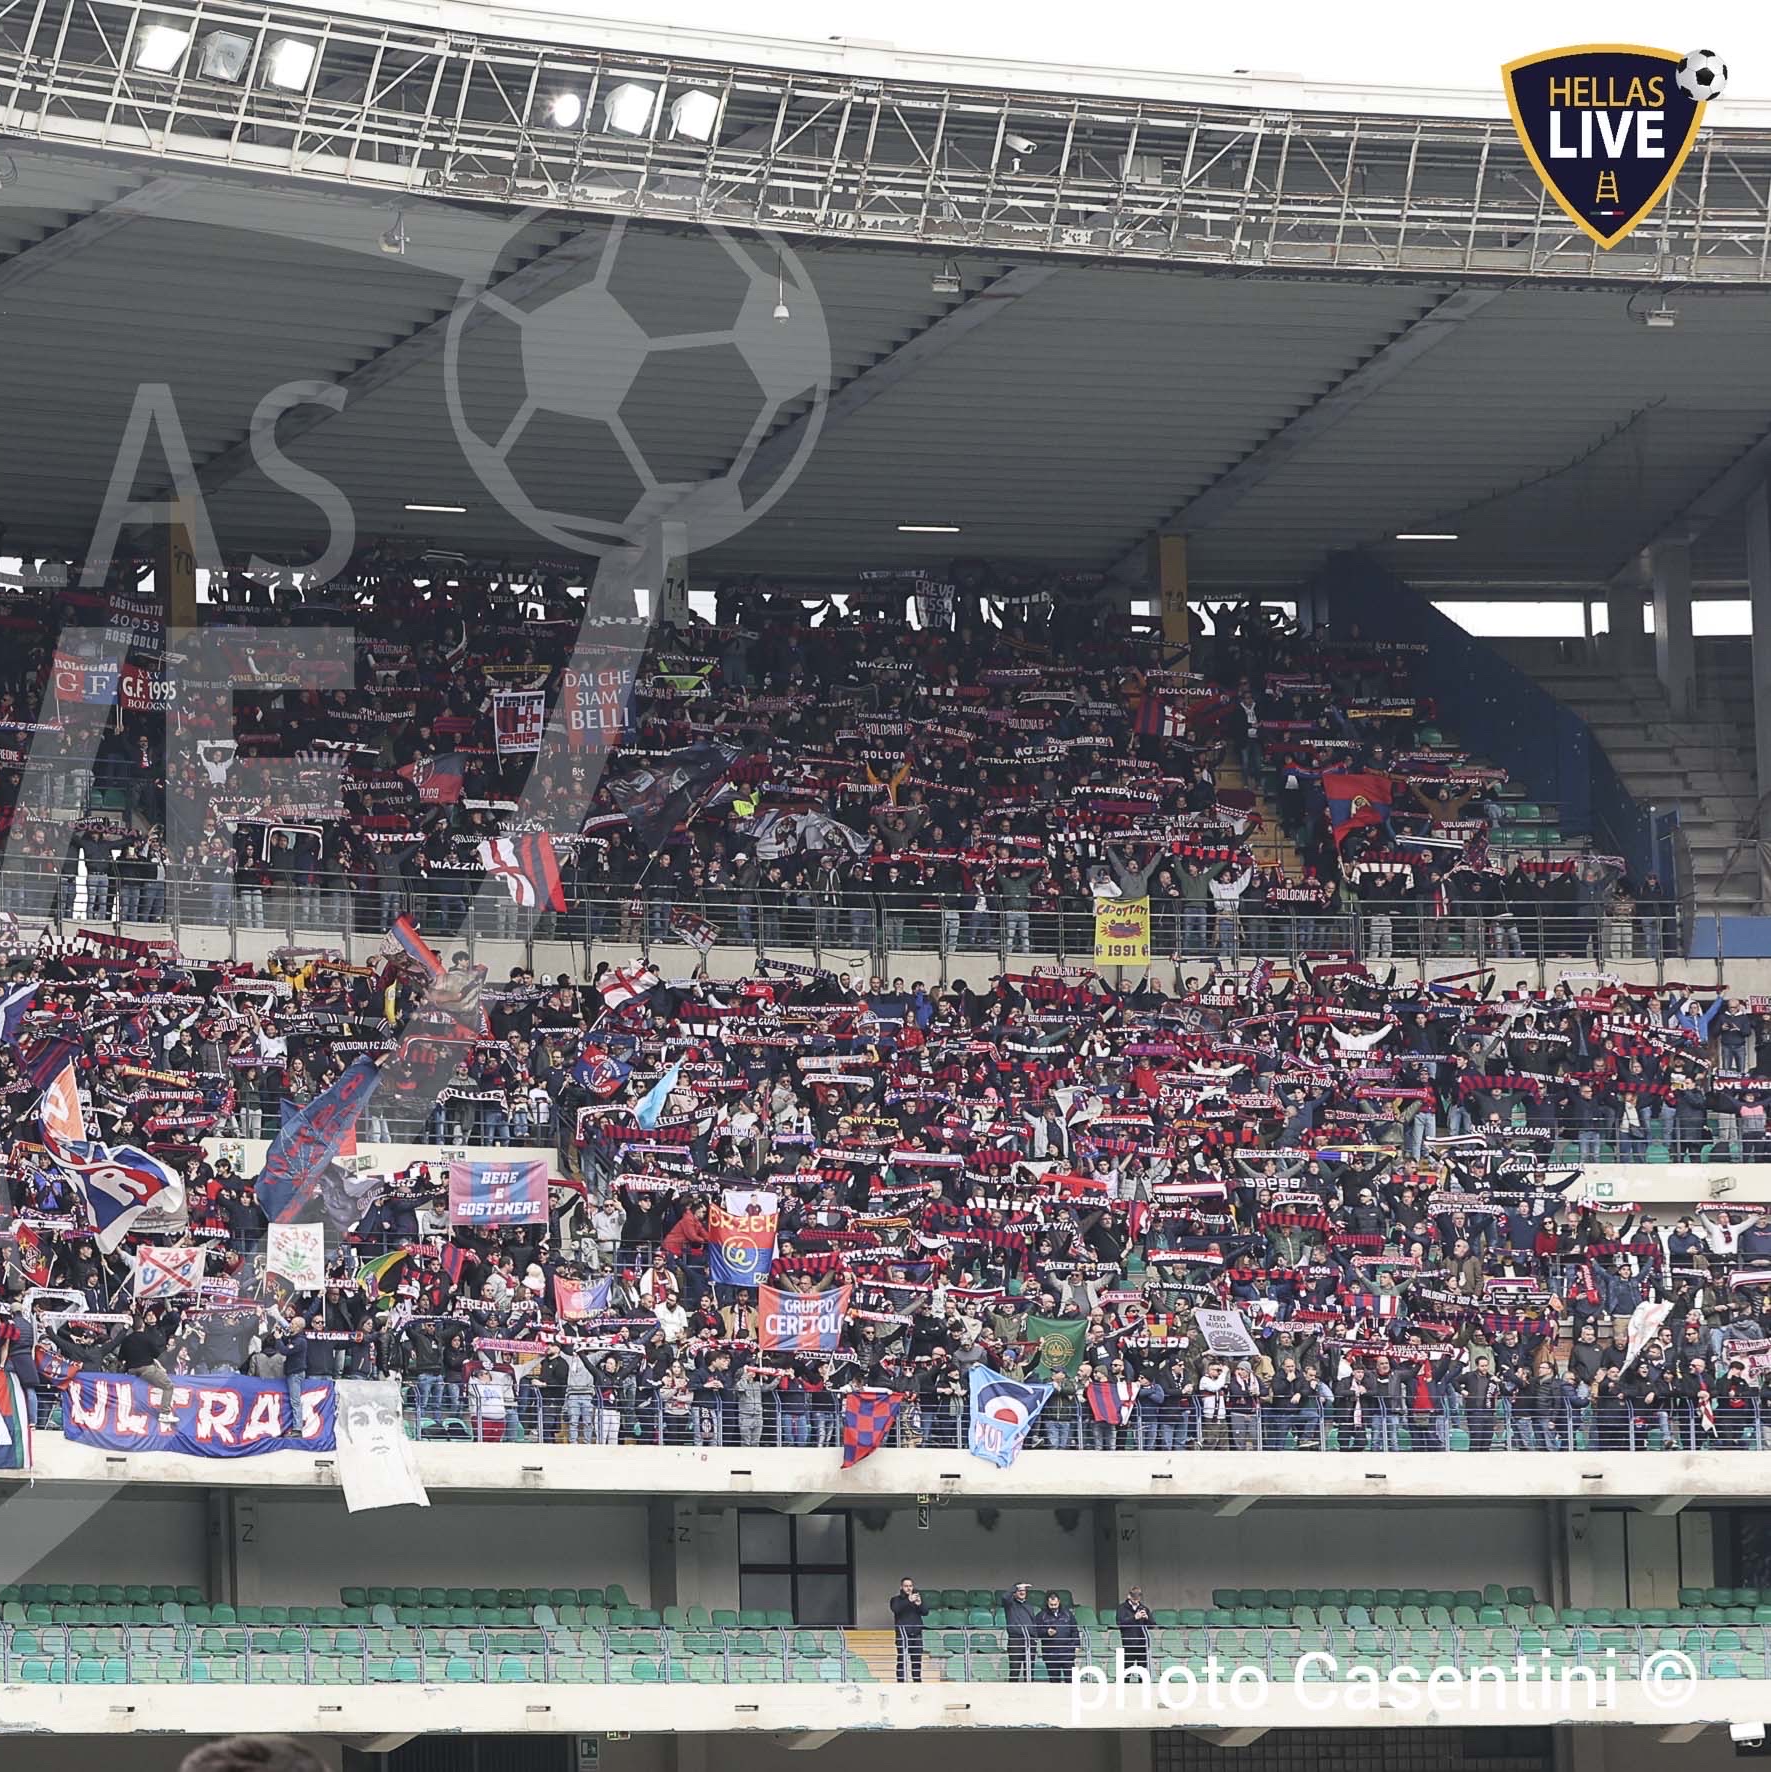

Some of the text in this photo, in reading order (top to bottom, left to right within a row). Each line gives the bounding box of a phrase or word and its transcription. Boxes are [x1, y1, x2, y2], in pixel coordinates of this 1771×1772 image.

[109, 594, 163, 618] CASTELLETTO
[105, 627, 159, 651] ROSSOBLU
[54, 658, 118, 673] BOLOGNA
[855, 658, 914, 672] MAZZINI
[137, 668, 161, 679] XXV
[564, 669, 630, 689] DAI CHE
[147, 679, 177, 700] 1995
[1158, 686, 1213, 697] BOLOGNA
[127, 699, 173, 712] BOLOGNA
[571, 706, 629, 729] BELLI
[988, 756, 1021, 765] TRUPPA
[366, 832, 426, 843] ULTRAS
[429, 859, 486, 871] MAZZIN
[1276, 888, 1310, 901] BOLOGNA
[1096, 902, 1149, 915] CAPOTTATI
[1108, 944, 1137, 957] 1991
[1199, 994, 1236, 1007] WEAREONE
[1326, 1007, 1367, 1018] BOLOGNA
[1334, 1050, 1365, 1061] BOLOGNA
[481, 1170, 520, 1185] BERE
[495, 1188, 504, 1199] E
[457, 1201, 542, 1217] SOSTENERE
[1159, 1209, 1186, 1219] BOYS
[785, 1298, 833, 1313] GRUPPO
[1206, 1320, 1233, 1329] MIGLIA
[1207, 1314, 1227, 1323] ZERO
